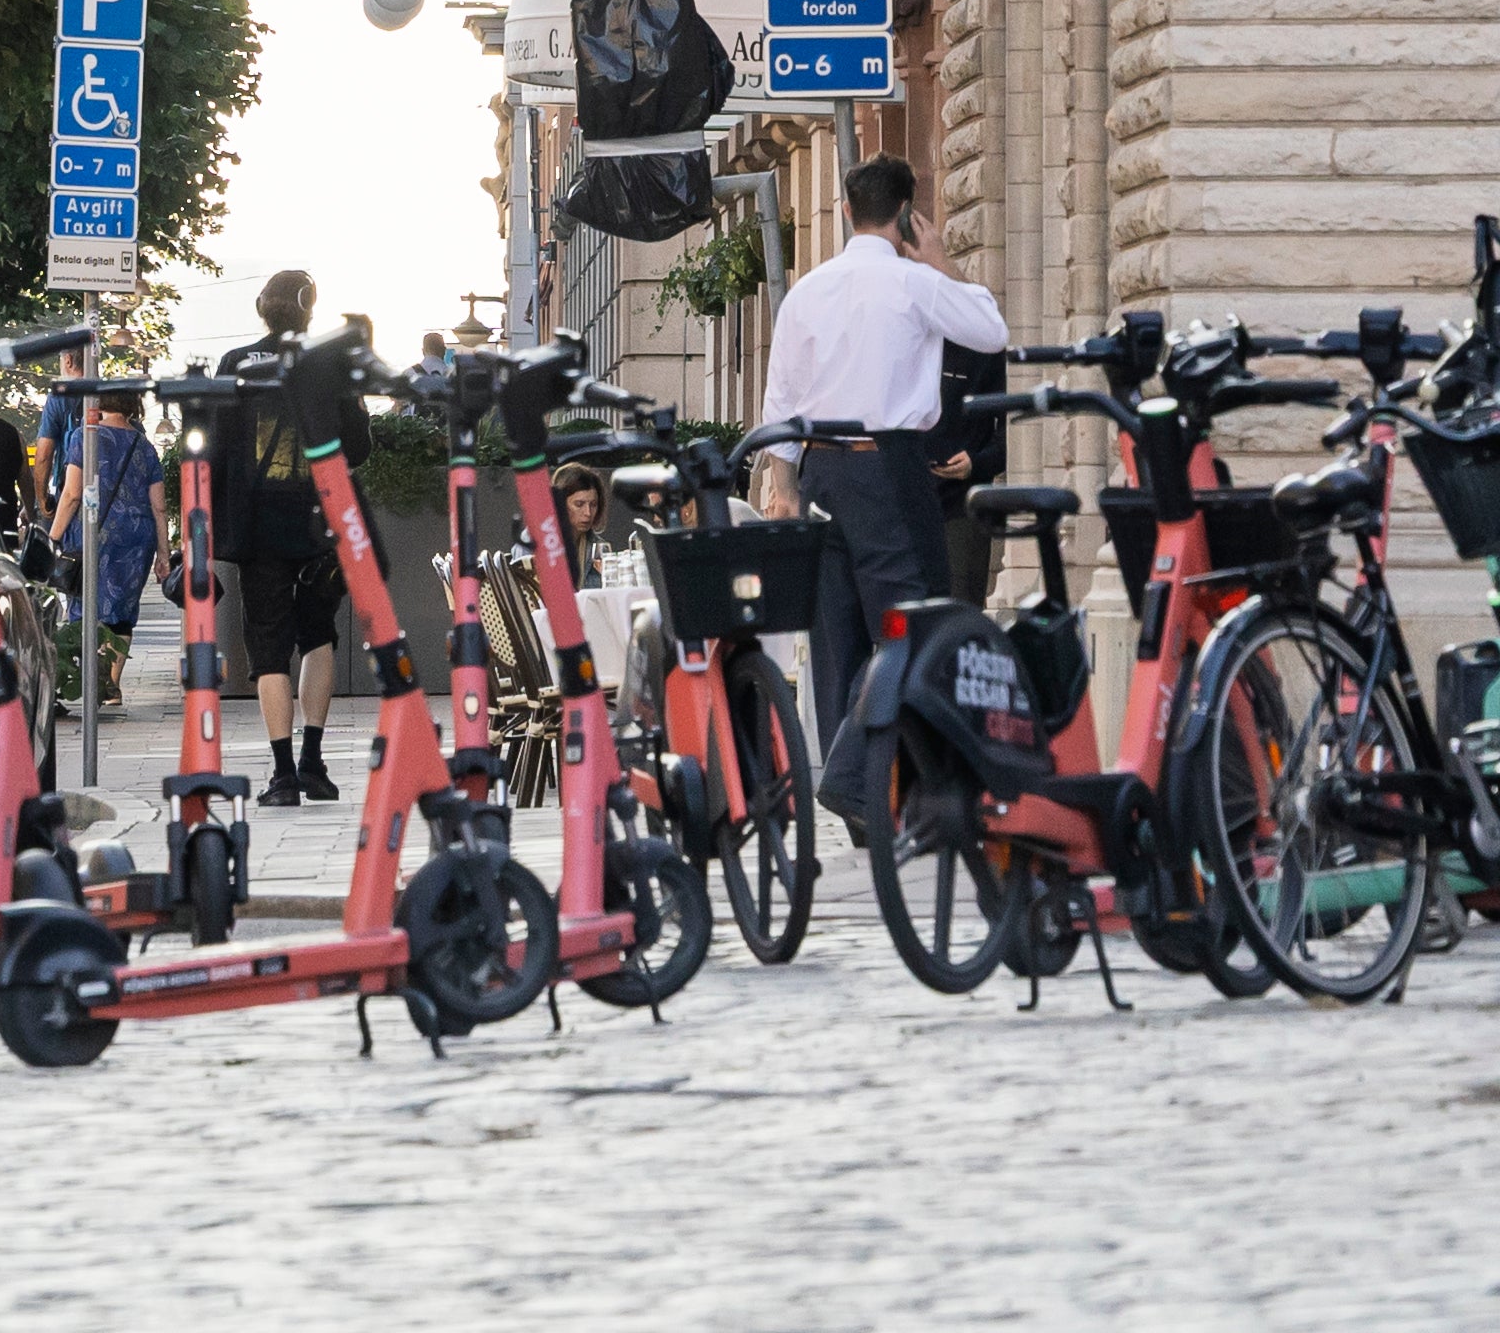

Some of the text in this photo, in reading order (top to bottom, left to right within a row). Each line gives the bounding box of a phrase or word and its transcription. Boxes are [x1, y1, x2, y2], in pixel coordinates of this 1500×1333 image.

[802, 0, 857, 16] fordon
[736, 31, 765, 62] Ad
[862, 56, 884, 75] m
[92, 158, 105, 175] 7
[116, 163, 132, 177] m
[66, 197, 123, 218] Avgift
[62, 218, 122, 235] Taxa 1
[53, 254, 115, 267] Betala digitalt
